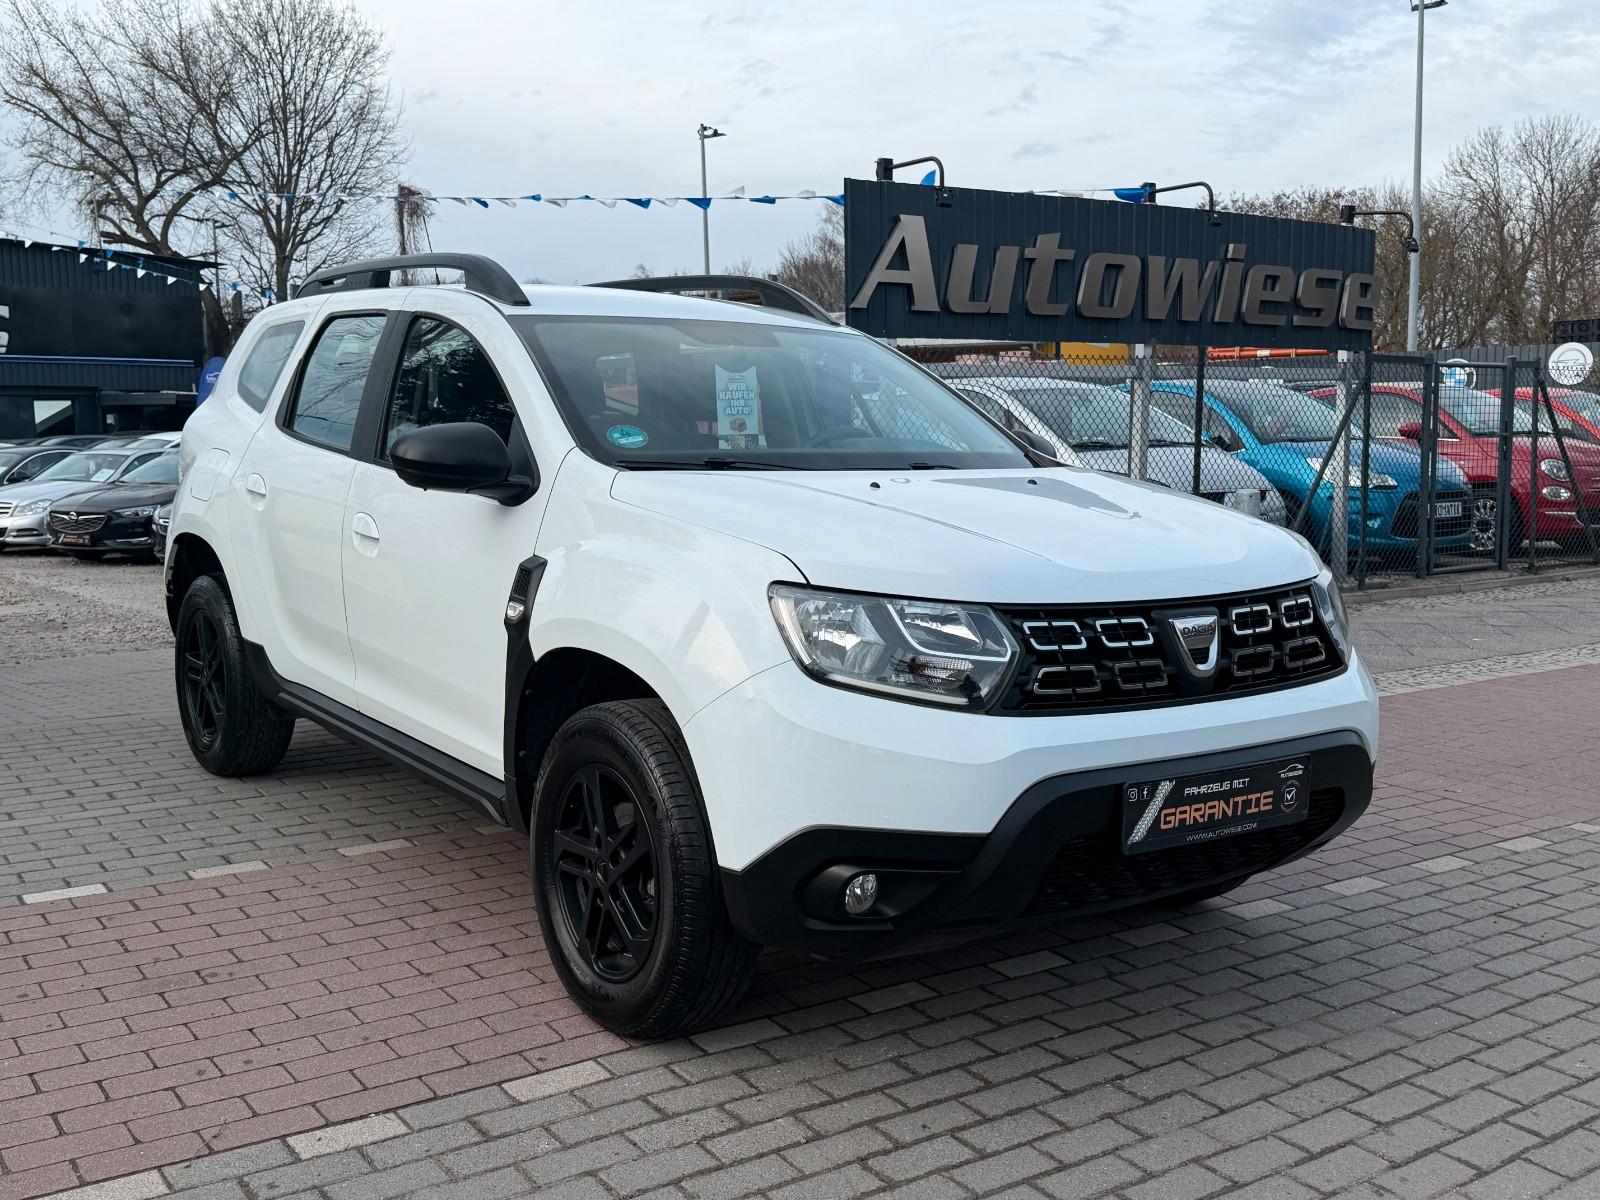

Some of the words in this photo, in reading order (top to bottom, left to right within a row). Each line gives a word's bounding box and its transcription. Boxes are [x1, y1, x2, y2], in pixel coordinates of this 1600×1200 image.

[849, 213, 1377, 329] Autowiese
[727, 382, 746, 391] WIR
[719, 390, 755, 400] KAUFEN
[1182, 624, 1214, 636] DACIA
[1184, 780, 1231, 797] FAHRZEUG
[1232, 777, 1250, 789] MIT
[1160, 790, 1274, 830] GARANTIE
